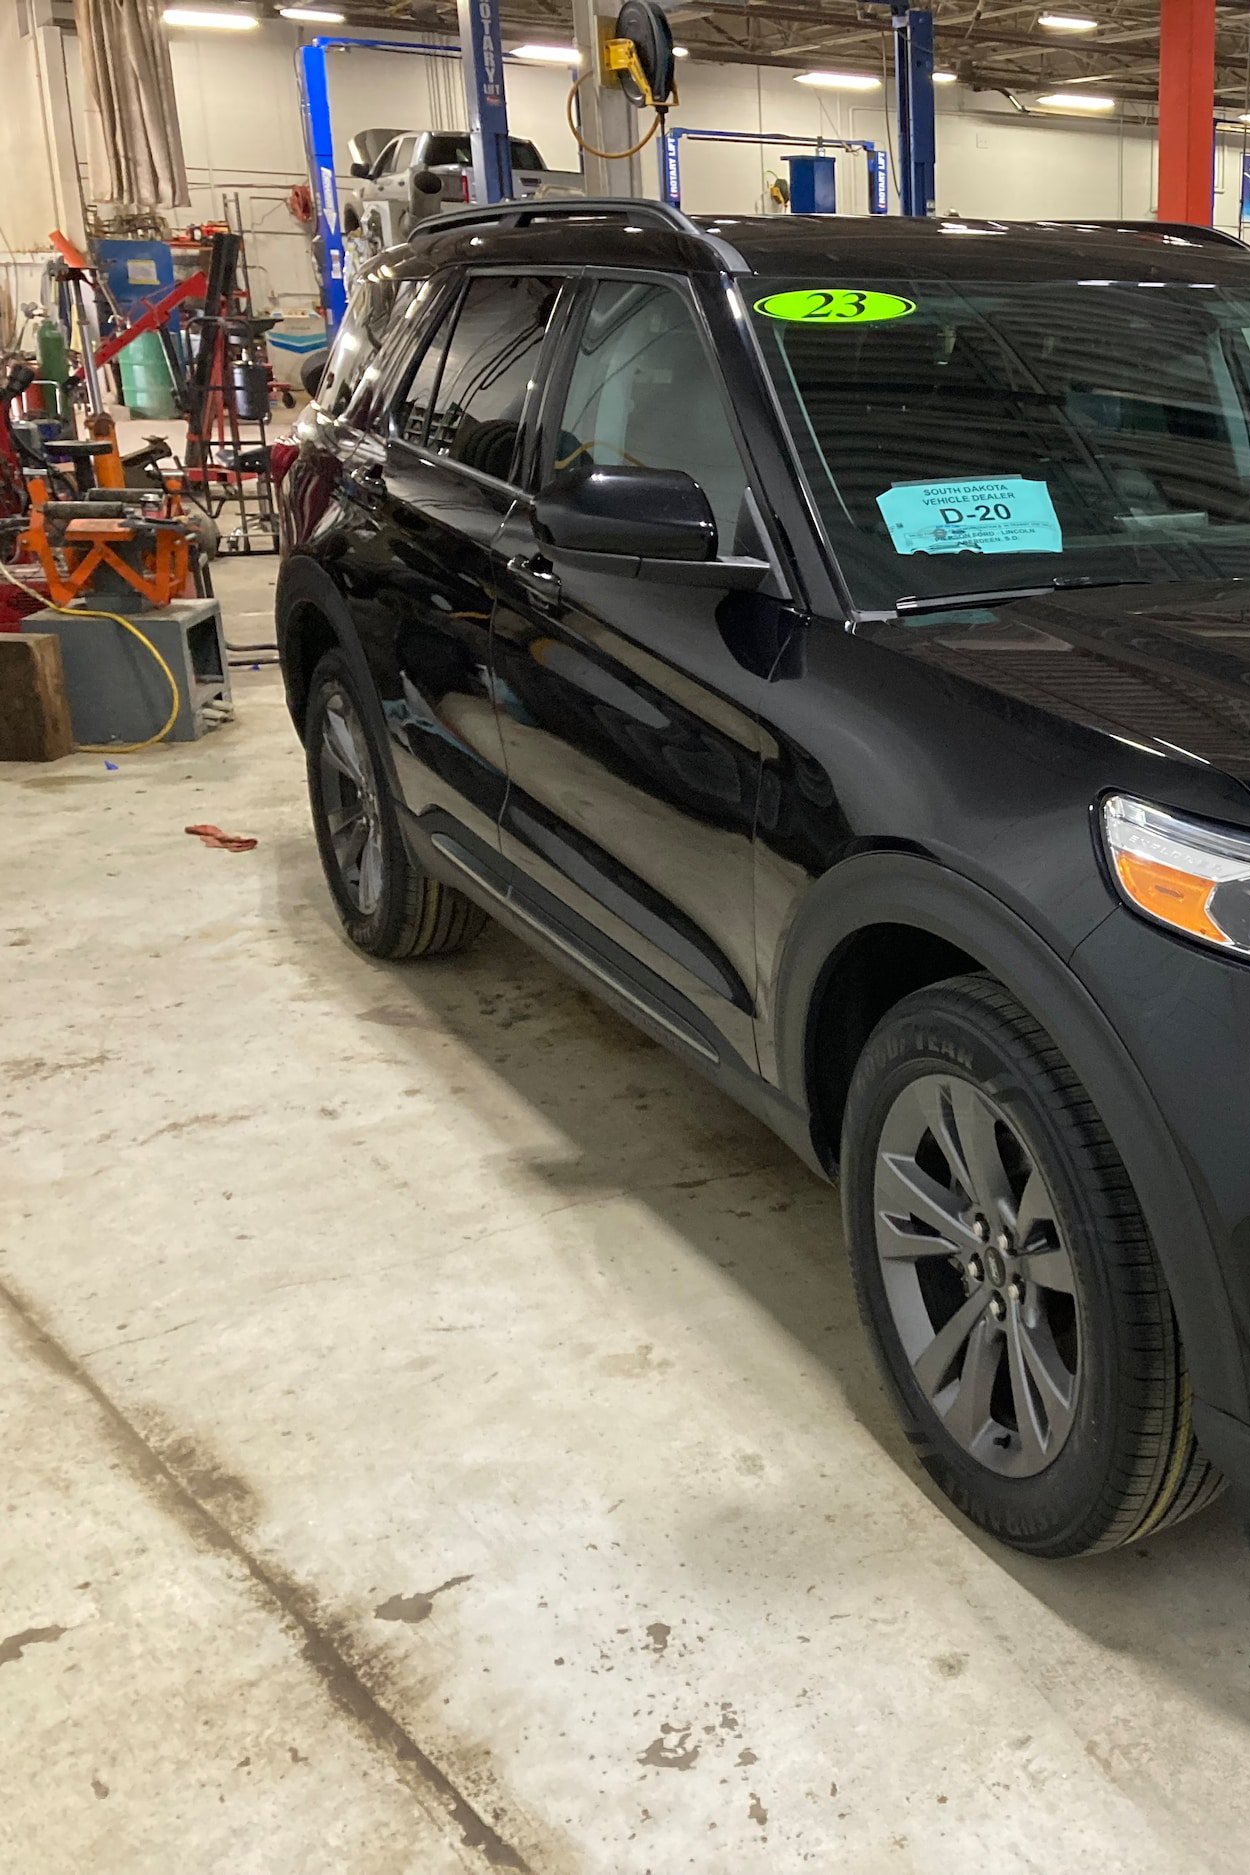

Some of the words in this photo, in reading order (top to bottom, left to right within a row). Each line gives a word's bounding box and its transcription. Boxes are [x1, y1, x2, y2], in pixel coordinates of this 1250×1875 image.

[479, 0, 495, 83] OTARY
[667, 137, 676, 157] LIFT
[668, 159, 678, 193] ROTARY
[878, 171, 886, 204] ROTARY
[801, 292, 867, 318] 23
[922, 496, 970, 507] VEHICLE
[971, 491, 1016, 502] DEALER
[923, 487, 962, 497] SOUTH
[964, 483, 1009, 493] DAKOTA
[939, 503, 1012, 525] D-20
